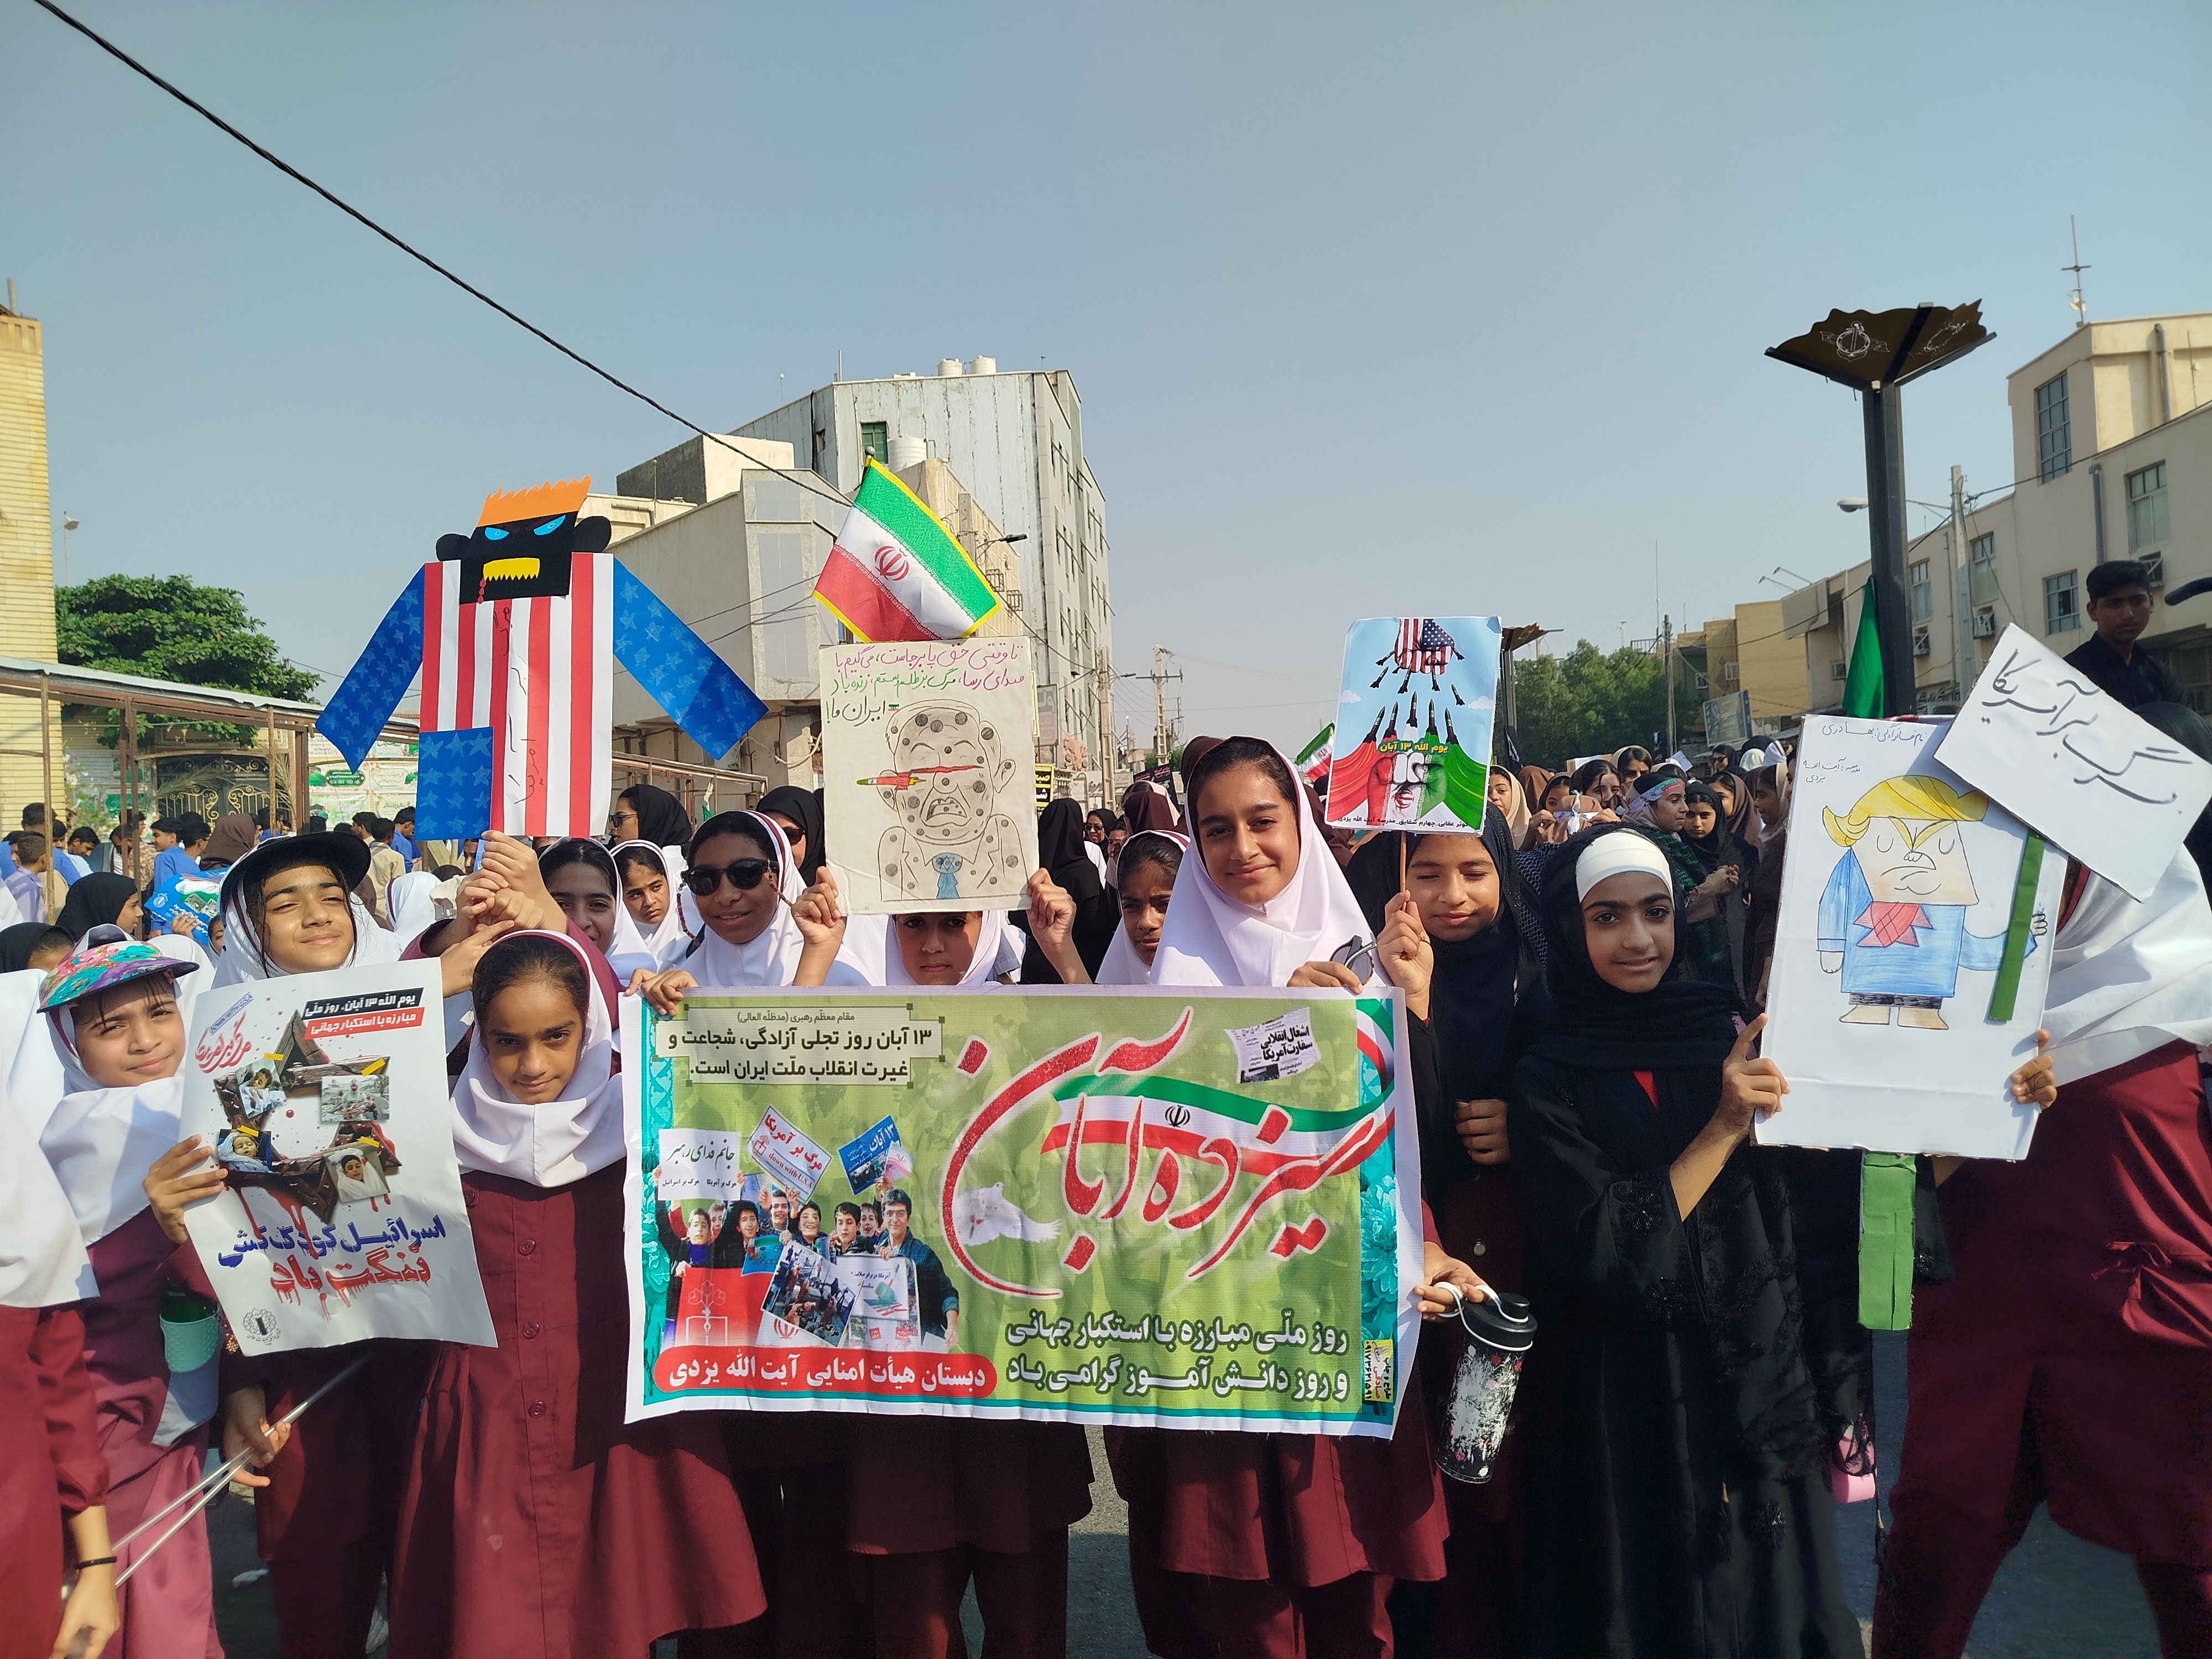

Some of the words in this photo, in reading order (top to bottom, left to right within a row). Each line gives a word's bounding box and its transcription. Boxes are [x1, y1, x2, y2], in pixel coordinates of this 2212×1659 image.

[835, 652, 843, 673] با
[936, 643, 969, 667] حق
[1010, 644, 1023, 660] تا
[831, 672, 851, 696] باد
[927, 668, 958, 690] مرگ
[983, 668, 1025, 691] صدای
[1981, 648, 2101, 726] آمریکا
[842, 695, 886, 727] ایران
[1380, 741, 1399, 753] آبان
[1400, 742, 1412, 750] ۱۳
[1415, 740, 1429, 750] الله
[2036, 713, 2099, 760] بر
[1806, 774, 1826, 783] یزدی
[2063, 733, 2193, 805] مرگ
[324, 1003, 340, 1014] روز
[364, 997, 378, 1008] ۱۳
[379, 993, 397, 1006] الله
[397, 994, 416, 1008] یوم
[311, 1021, 340, 1035] جهانی
[340, 1016, 376, 1030] استکبار
[377, 1016, 385, 1027] با
[385, 1013, 416, 1025] مبارزه
[790, 1013, 812, 1023] رهبری
[837, 1011, 855, 1024] مقام
[668, 1034, 678, 1050] و
[681, 1027, 736, 1050] شجاعت
[801, 1029, 839, 1051] تجلی
[843, 1030, 872, 1050] روز
[877, 1026, 910, 1051] آبان
[913, 1029, 932, 1045] ۱۳
[1260, 1029, 1287, 1050] انقلابی
[1286, 1024, 1310, 1043] اشغال
[1262, 1043, 1288, 1062] آمریکا
[1287, 1039, 1313, 1056] سفارت
[690, 1060, 731, 1074] است.
[734, 1060, 769, 1081] ایران
[809, 1060, 858, 1082] انقلاب
[861, 1060, 909, 1082] غیرت
[764, 1114, 797, 1145] آمریکا
[869, 1127, 886, 1152] آبان
[884, 1123, 895, 1139] ۱۳
[666, 1144, 692, 1165] رهبر
[690, 1140, 716, 1162] فدای
[715, 1139, 735, 1171] جانم
[789, 1146, 805, 1158] بر
[804, 1152, 823, 1170] مرگ
[769, 1152, 784, 1168] down
[784, 1164, 797, 1178] with
[706, 1178, 721, 1188] آمریکا
[725, 1180, 737, 1188] مرگ
[1142, 1107, 1378, 1279] سیزده
[269, 1223, 337, 1257] کودک
[340, 1214, 446, 1252] اسرائیل
[270, 1254, 328, 1302] باد
[1007, 1311, 1072, 1347] جهانی
[1076, 1313, 1149, 1346] استکبار
[1154, 1318, 1175, 1350] با
[1180, 1319, 1251, 1351] مبارزه
[1311, 1324, 1348, 1353] روز
[669, 1359, 720, 1387] یزدی
[726, 1348, 757, 1378] الله
[760, 1353, 801, 1386] آیت
[806, 1357, 865, 1386] امنایی
[870, 1355, 916, 1390] هیأت
[1008, 1355, 1044, 1388] باد
[1048, 1356, 1121, 1392] گرامی
[1383, 1357, 1391, 1374] چاپ
[921, 1362, 987, 1392] دبستان
[1125, 1358, 1211, 1394] آموز
[1215, 1363, 1289, 1395] دانش
[1294, 1370, 1328, 1399] روز
[1334, 1373, 1348, 1400] و
[1373, 1366, 1383, 1399] صادقی
[1383, 1381, 1392, 1400] طراح
